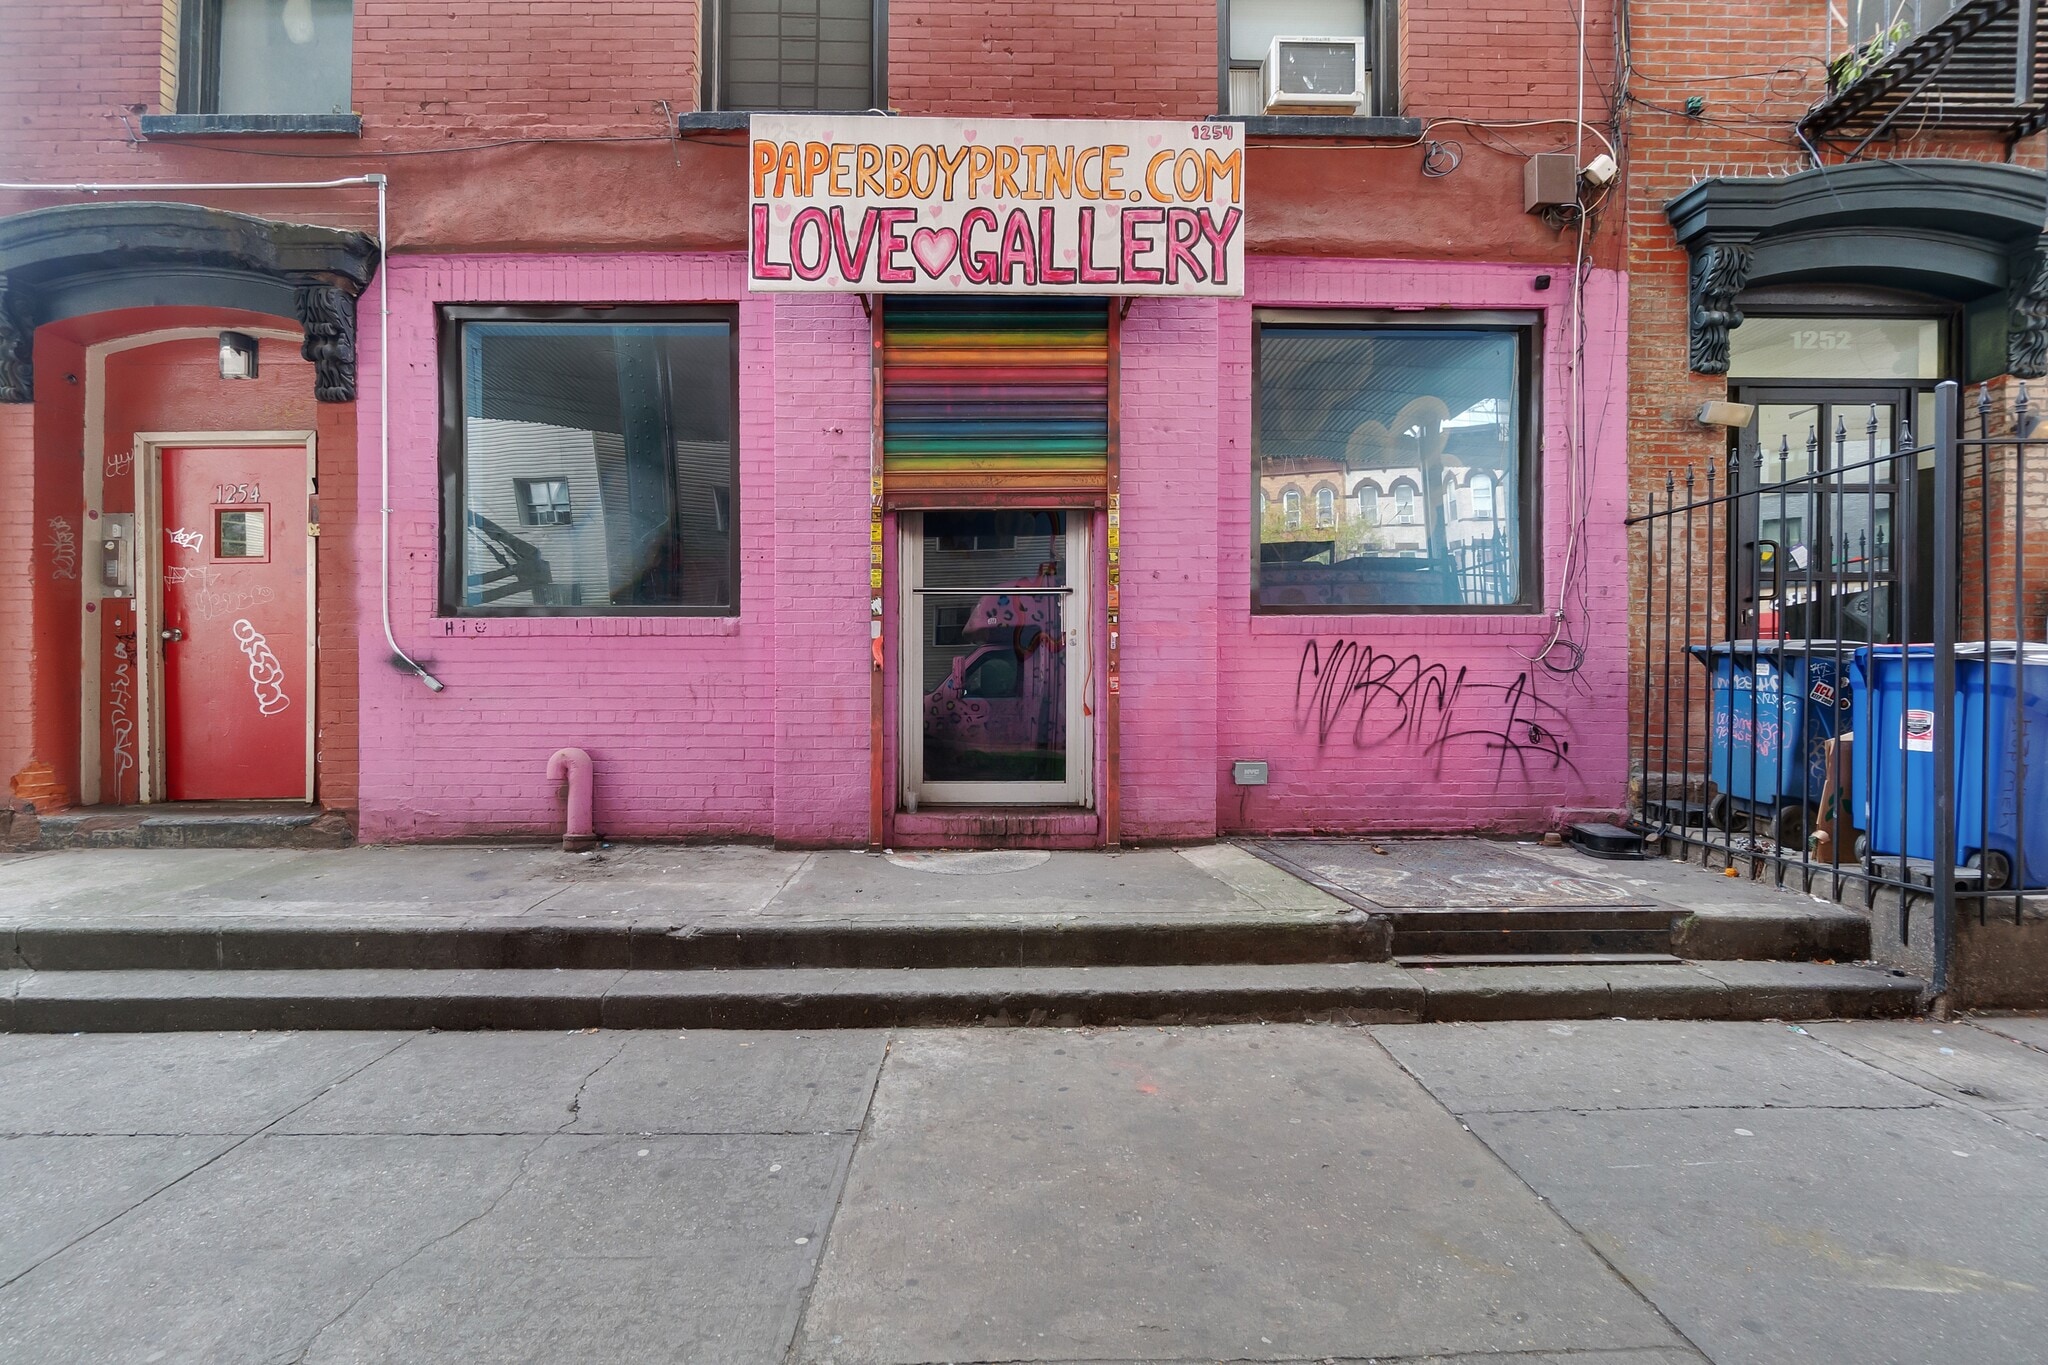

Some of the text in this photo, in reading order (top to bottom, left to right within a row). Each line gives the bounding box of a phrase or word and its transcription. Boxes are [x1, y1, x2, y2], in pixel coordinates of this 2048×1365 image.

[1191, 125, 1233, 140] 1254
[752, 139, 1242, 203] PAPERBOYPRINCE.COM
[752, 203, 1244, 285] LOVE GALLERY
[1790, 330, 1851, 350] 1252
[216, 483, 261, 504] 1254
[445, 620, 466, 636] Hi
